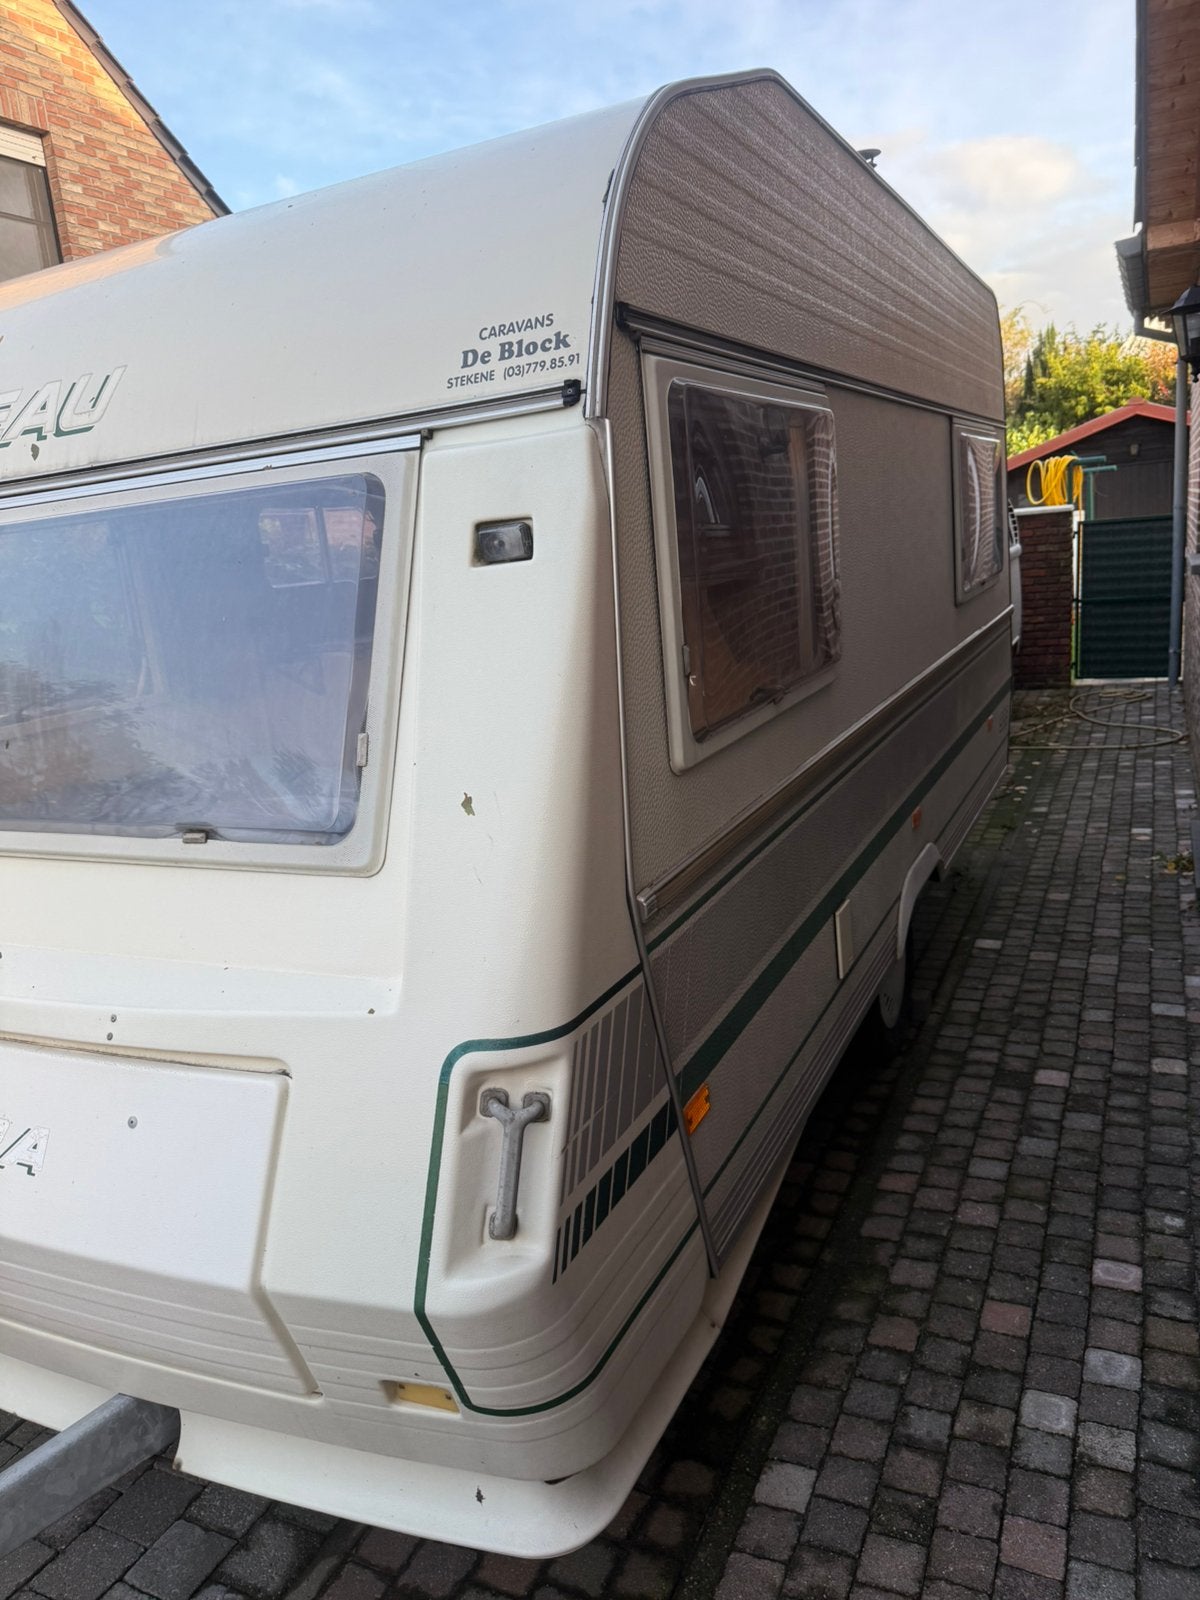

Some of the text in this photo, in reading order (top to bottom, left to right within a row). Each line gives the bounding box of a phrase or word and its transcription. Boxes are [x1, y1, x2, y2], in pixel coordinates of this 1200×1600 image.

[479, 313, 554, 340] CARAVANS
[461, 331, 571, 369] De Block
[447, 353, 580, 389] STEKENE (03)779.85.91
